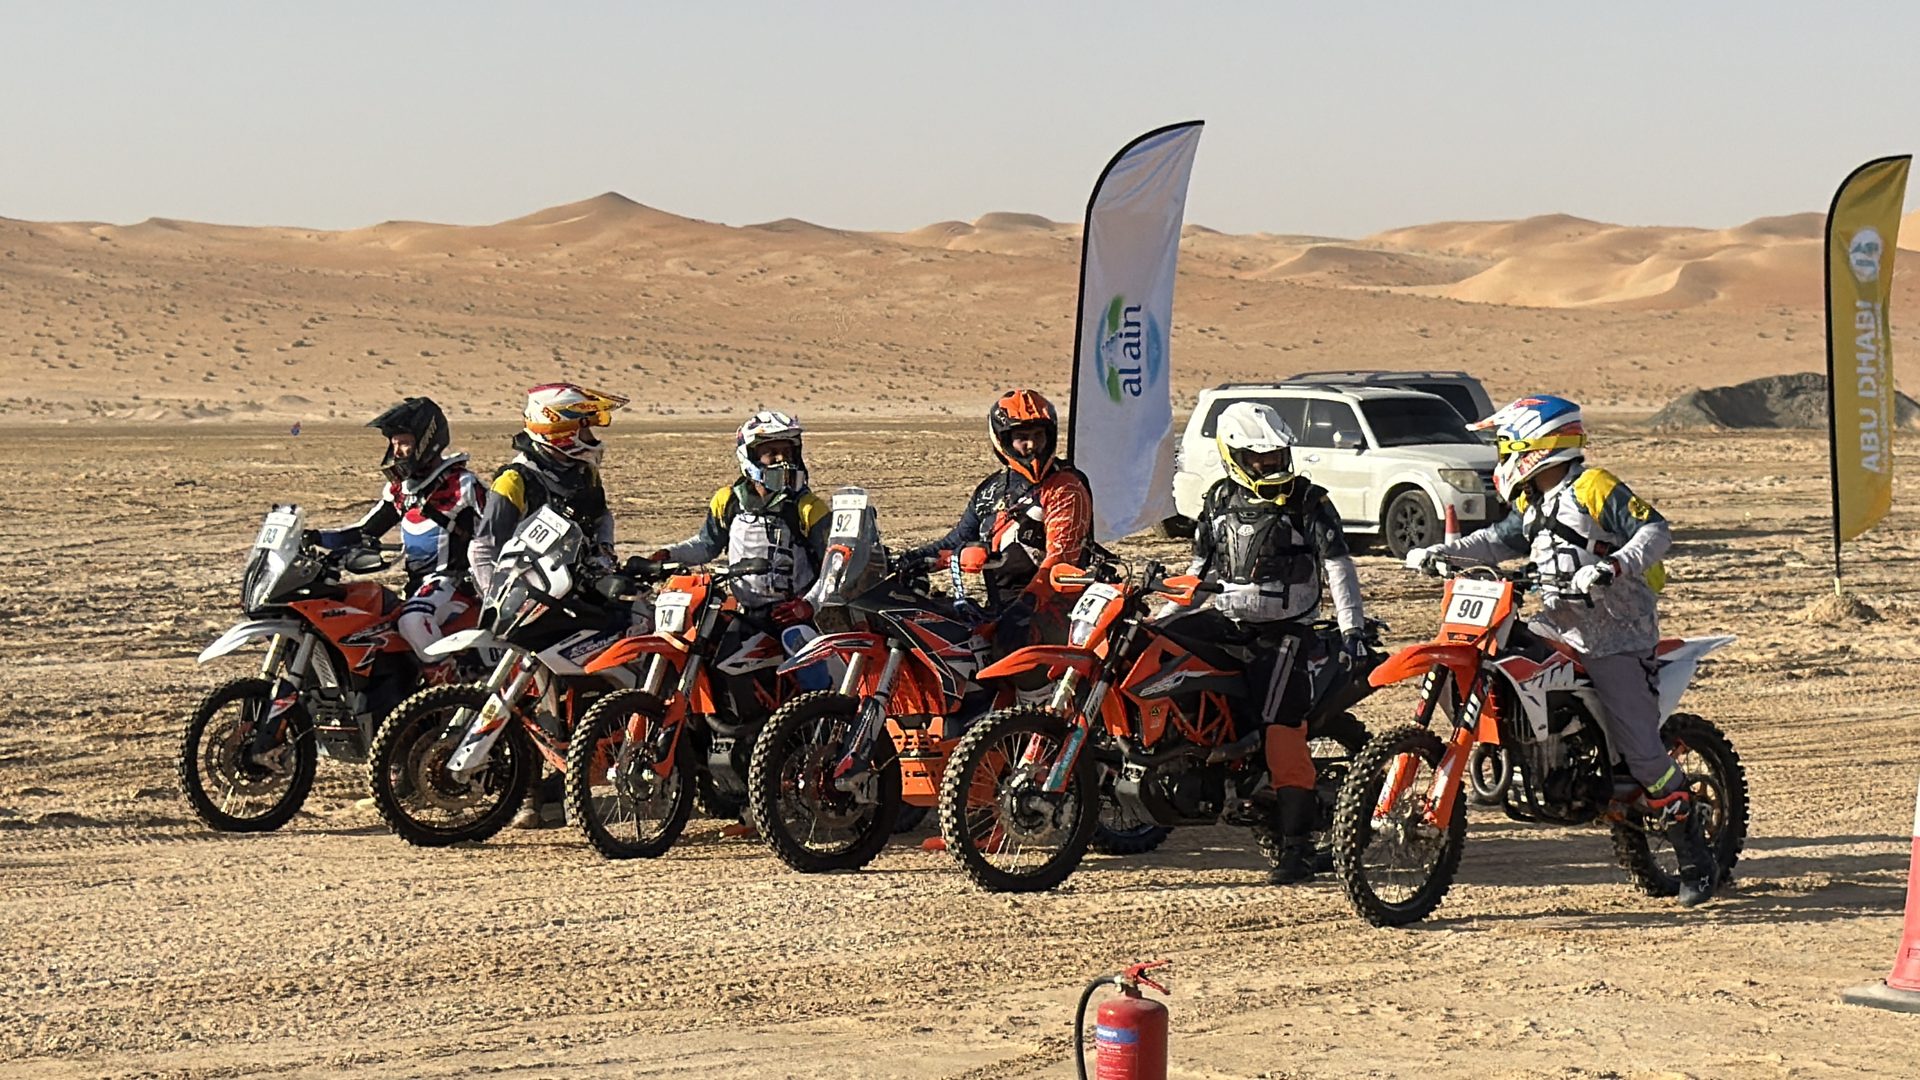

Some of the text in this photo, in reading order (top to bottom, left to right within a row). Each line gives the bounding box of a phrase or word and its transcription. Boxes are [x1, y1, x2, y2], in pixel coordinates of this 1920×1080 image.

[1118, 304, 1142, 397] al ain
[1855, 300, 1880, 473] ABU DHABI
[835, 513, 852, 532] 92
[528, 524, 549, 544] 60
[1457, 598, 1484, 619] 90
